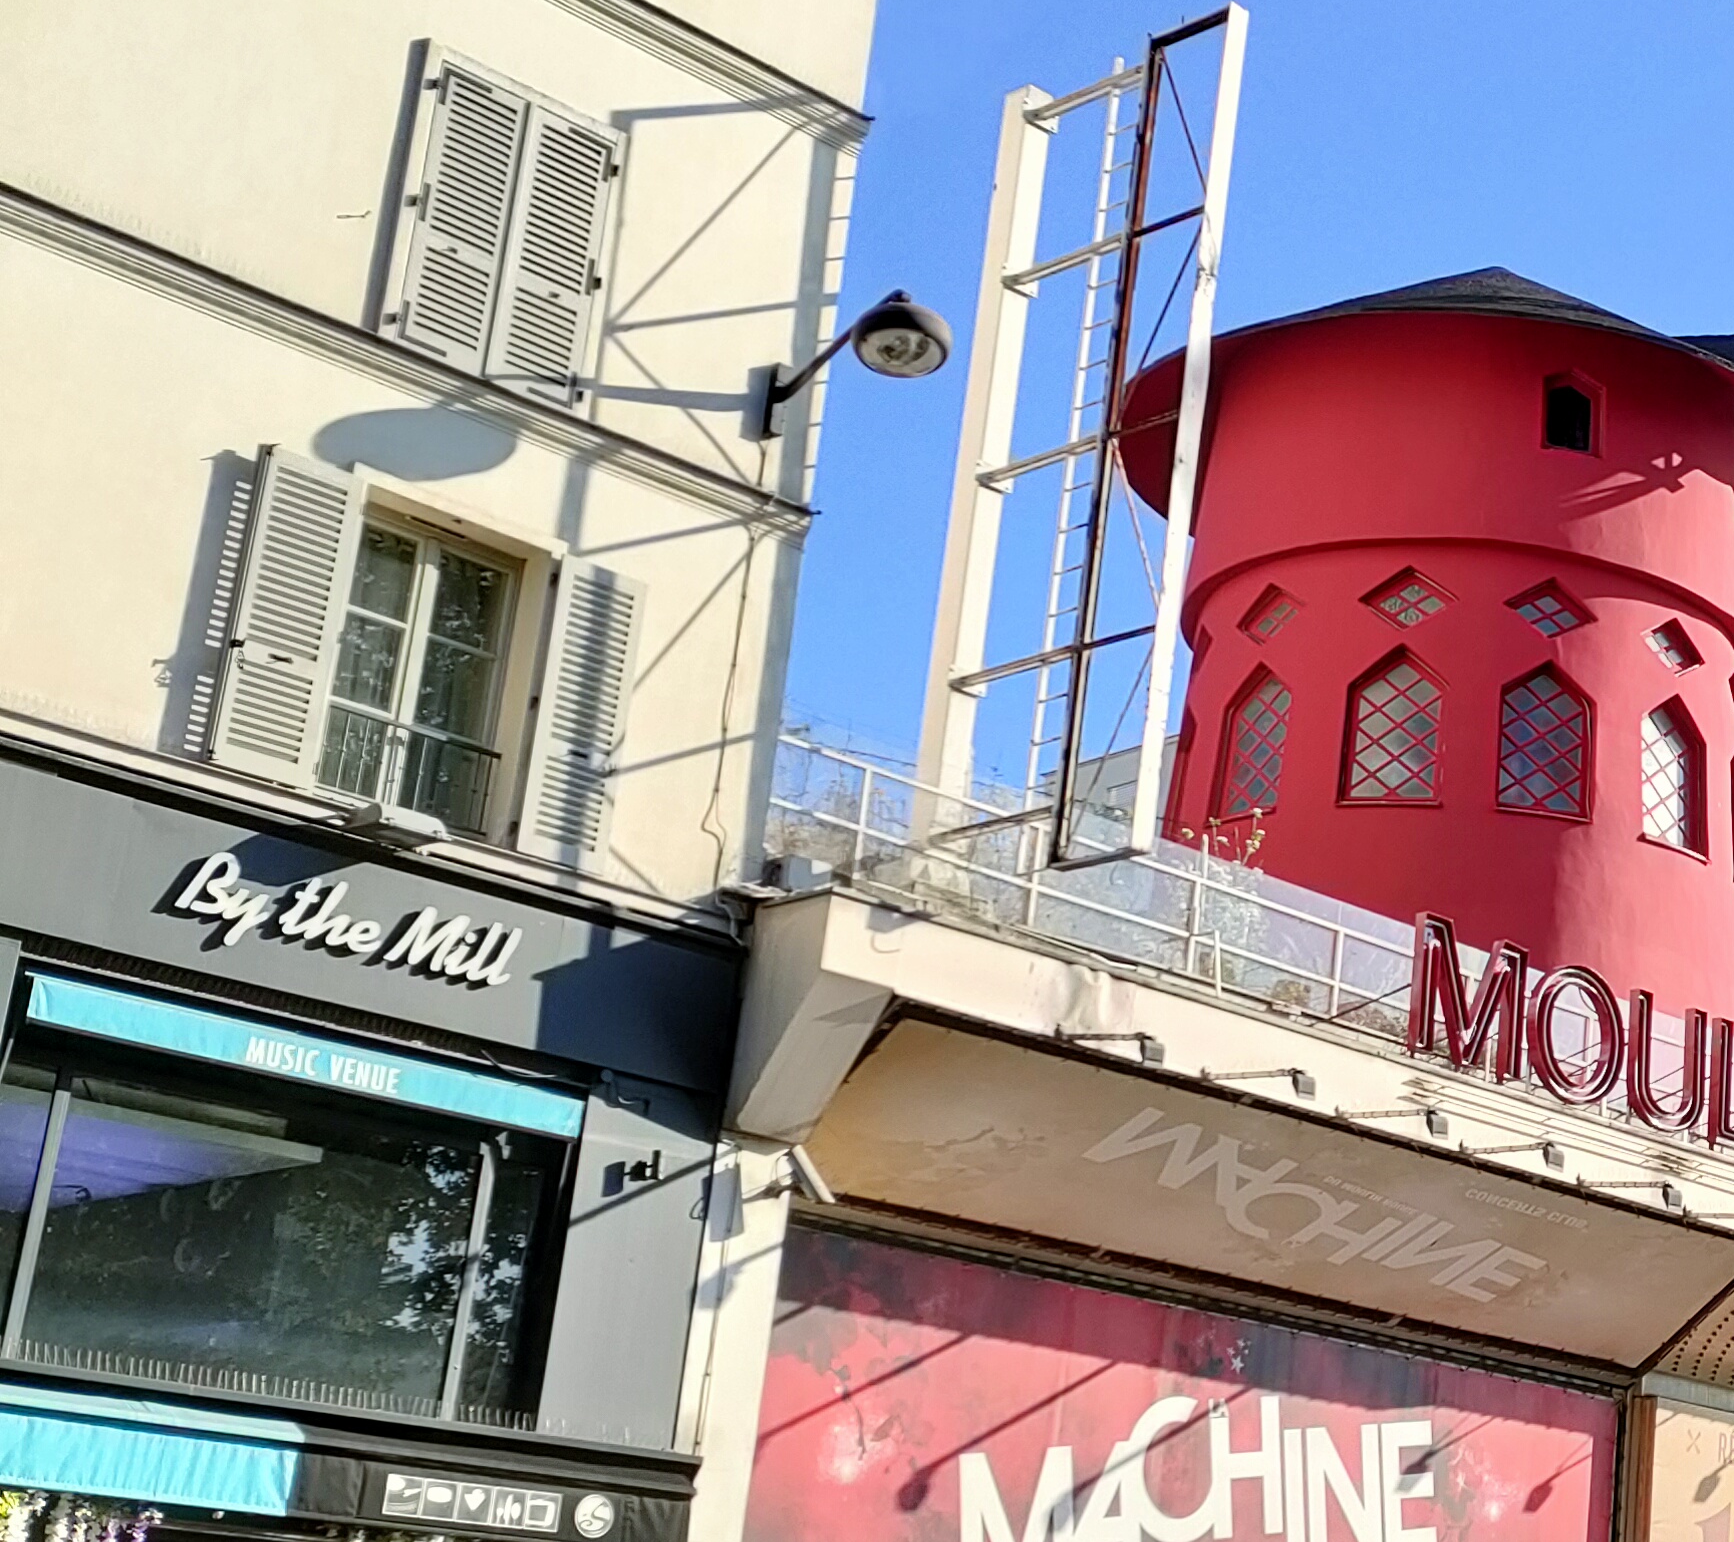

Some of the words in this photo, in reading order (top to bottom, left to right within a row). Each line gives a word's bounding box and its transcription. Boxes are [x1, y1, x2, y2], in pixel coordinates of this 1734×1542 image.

[174, 851, 270, 947] By
[278, 876, 382, 953] the
[383, 905, 523, 986] Mill
[245, 1036, 320, 1077] MUSIC
[329, 1056, 402, 1094] VENUE
